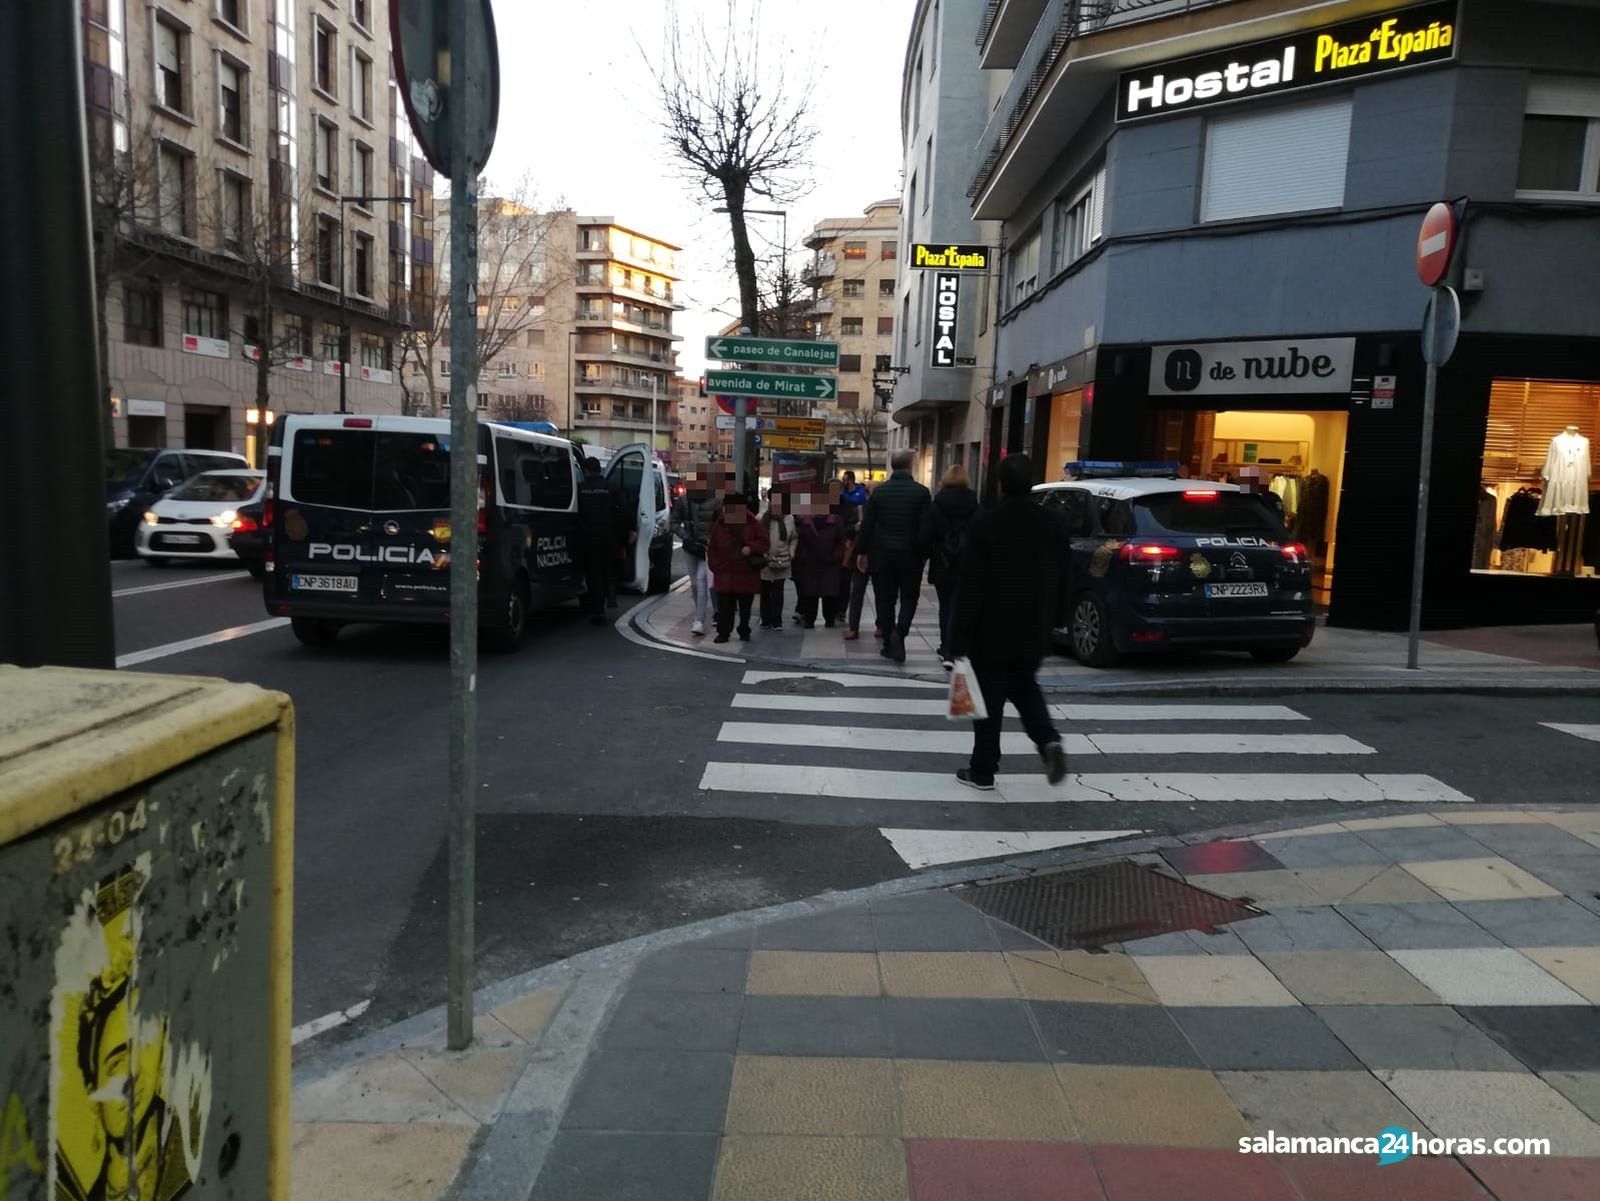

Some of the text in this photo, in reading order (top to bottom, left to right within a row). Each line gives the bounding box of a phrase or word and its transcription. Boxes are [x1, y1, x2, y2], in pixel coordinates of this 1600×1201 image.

[1127, 18, 1453, 113] Hostal Plaza de España
[916, 245, 946, 265] Plaza
[949, 246, 985, 269] España
[935, 276, 957, 364] HOSTAL
[733, 344, 836, 360] paseo de Canalejas
[1209, 361, 1236, 380] de
[1242, 347, 1336, 379] nube
[707, 377, 805, 392] avenida de Mirat
